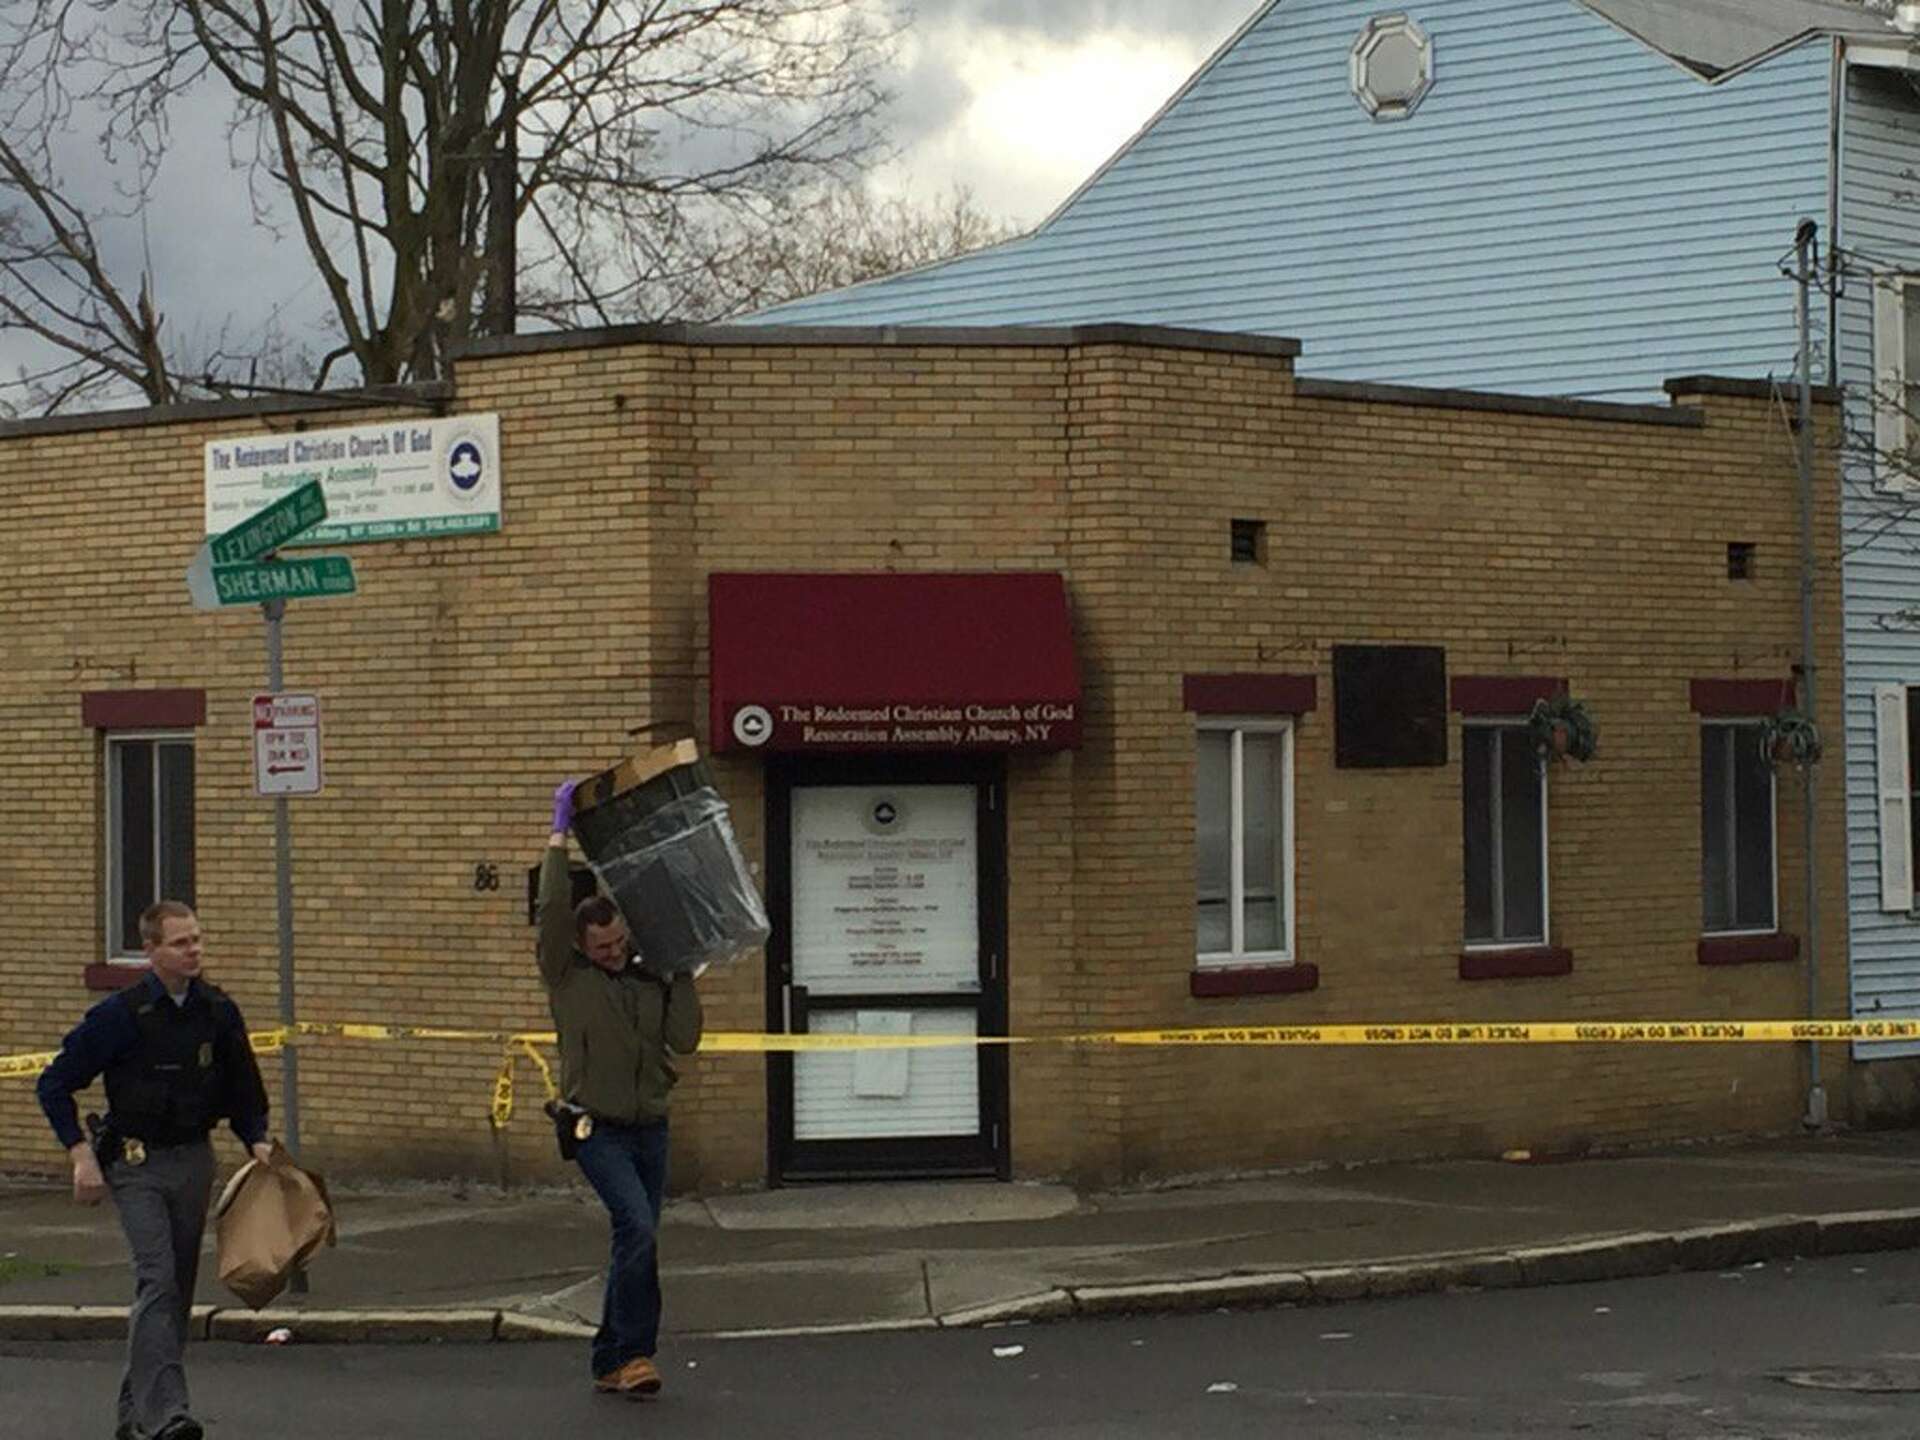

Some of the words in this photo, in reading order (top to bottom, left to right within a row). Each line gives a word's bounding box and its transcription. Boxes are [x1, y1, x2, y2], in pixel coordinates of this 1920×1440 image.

[294, 437, 345, 463] Christian
[219, 566, 318, 599] SHERMAN
[780, 704, 812, 722] The
[814, 704, 890, 722] Redeemed
[893, 703, 962, 722] Christian
[965, 703, 1021, 721] Church
[1023, 703, 1040, 721] of
[1041, 703, 1073, 721] God
[891, 724, 961, 745] Assembly
[1025, 724, 1050, 741] NY
[1409, 1028, 1431, 1040] NOT
[1457, 1028, 1483, 1039] LINE
[1488, 1027, 1529, 1039] POLICE
[1576, 1027, 1616, 1040] CROSS
[1620, 1027, 1645, 1039] NOT
[1649, 1026, 1665, 1038] DO
[1671, 1026, 1697, 1038] LINE
[1702, 1025, 1744, 1037] POLICE
[1791, 1025, 1833, 1037] CROSS
[1837, 1024, 1862, 1036] NOT
[1866, 1024, 1883, 1036] DO
[1888, 1023, 1917, 1034] LINE
[1278, 1030, 1320, 1041] POLICE
[1365, 1029, 1403, 1041] CROSS
